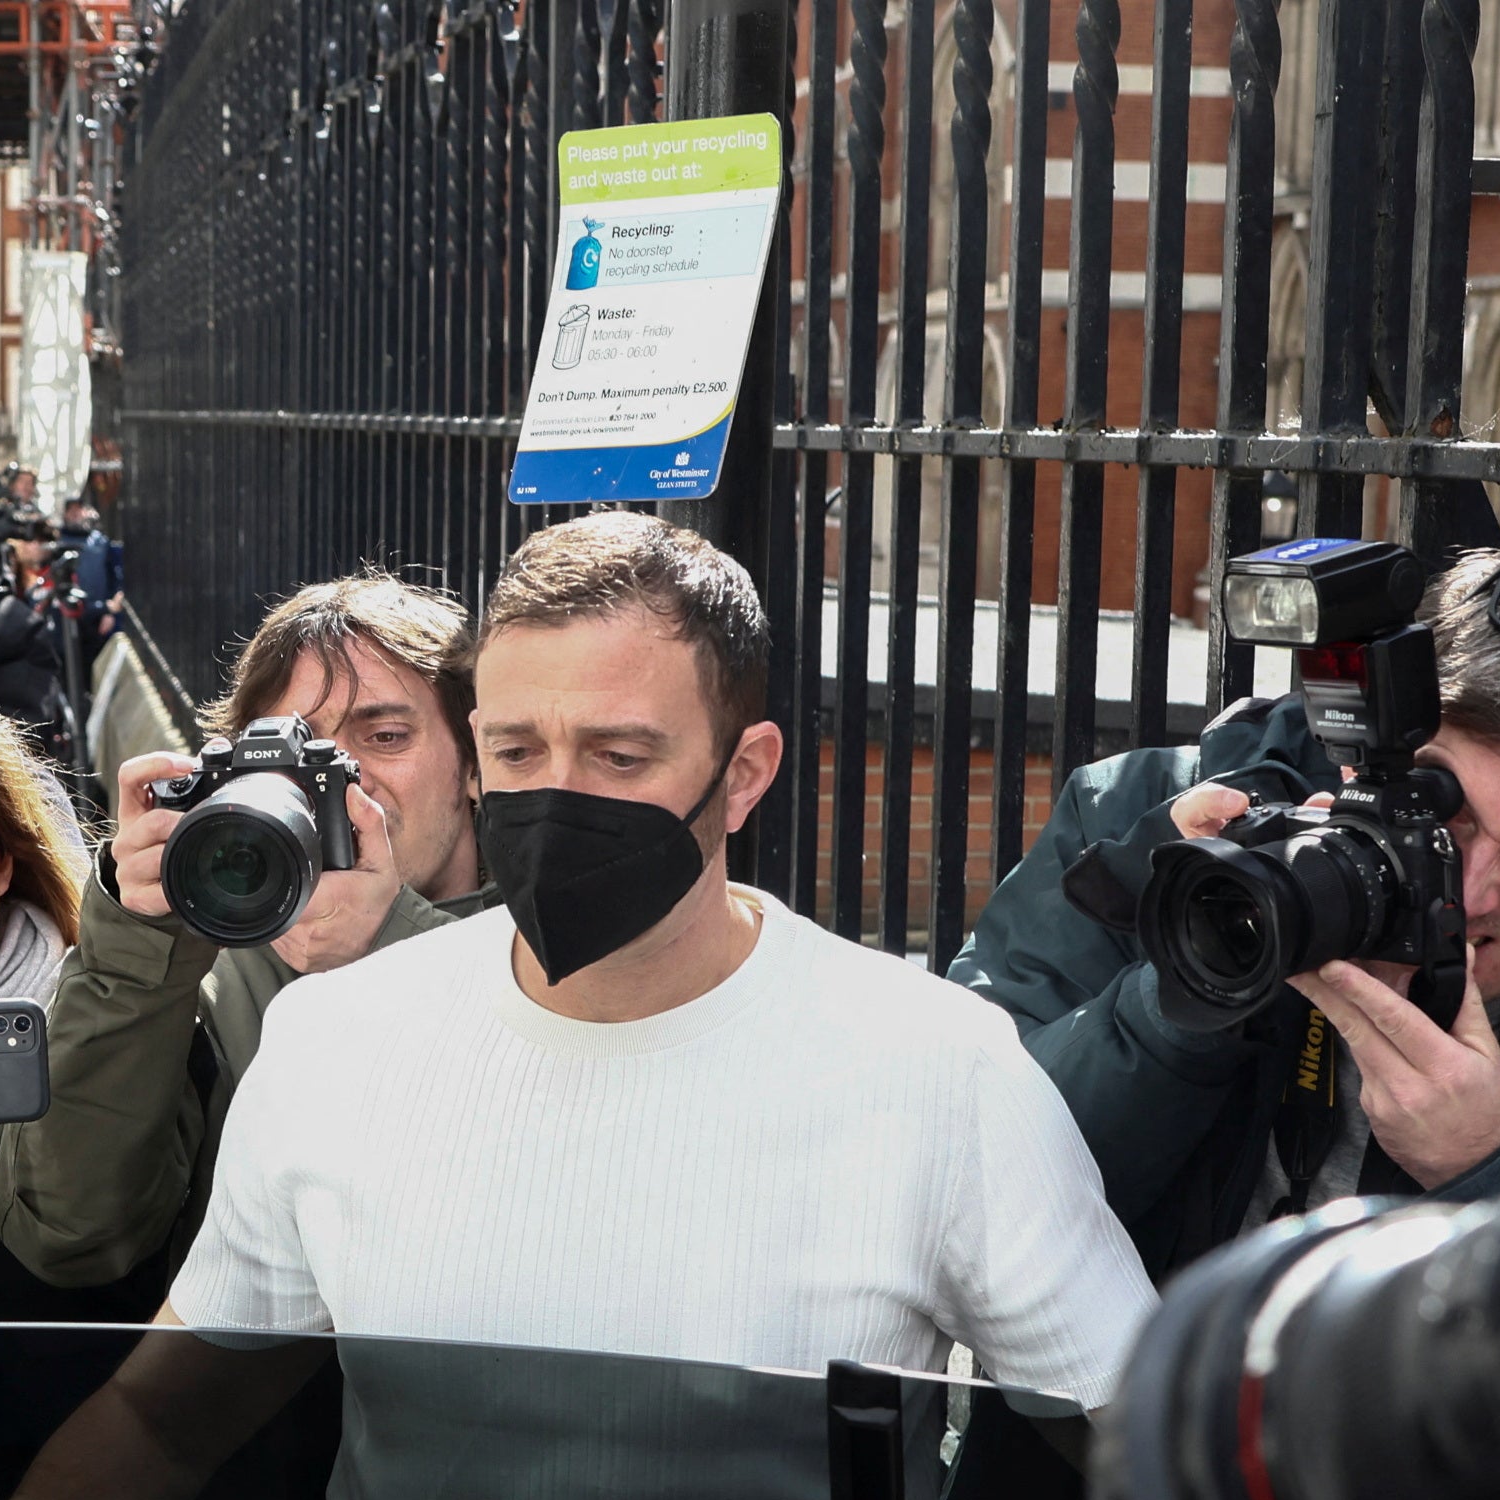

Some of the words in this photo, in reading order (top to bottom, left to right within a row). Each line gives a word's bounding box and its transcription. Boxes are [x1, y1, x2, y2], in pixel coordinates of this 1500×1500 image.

[567, 146, 618, 163] Please
[622, 140, 648, 161] put
[653, 138, 688, 159] your
[693, 130, 768, 153] recycling
[568, 170, 597, 189] and
[601, 168, 647, 185] waste
[651, 164, 677, 182] out
[682, 161, 703, 179] at:
[611, 223, 675, 239] Recycling:
[608, 248, 623, 259] No
[626, 244, 672, 258] doorstep
[605, 262, 650, 277] recycling
[652, 258, 699, 274] schedule
[597, 308, 636, 320] Waste:
[592, 328, 633, 341] Monday
[643, 324, 674, 338] Friday
[588, 348, 617, 361] 05:30
[627, 345, 657, 358] 06:00
[538, 391, 564, 403] Don't
[566, 388, 597, 402] Dump.
[601, 386, 650, 399] Maximum
[652, 383, 690, 398] penalty
[692, 381, 729, 394] £2,500.
[640, 412, 656, 420] 2000
[649, 469, 661, 480] City
[663, 469, 671, 478] of
[672, 468, 710, 478] Westminster
[1324, 709, 1355, 722] Nikon
[243, 749, 282, 760] SONY
[1339, 788, 1376, 803] Nikon
[1297, 1008, 1326, 1091] Nikon
